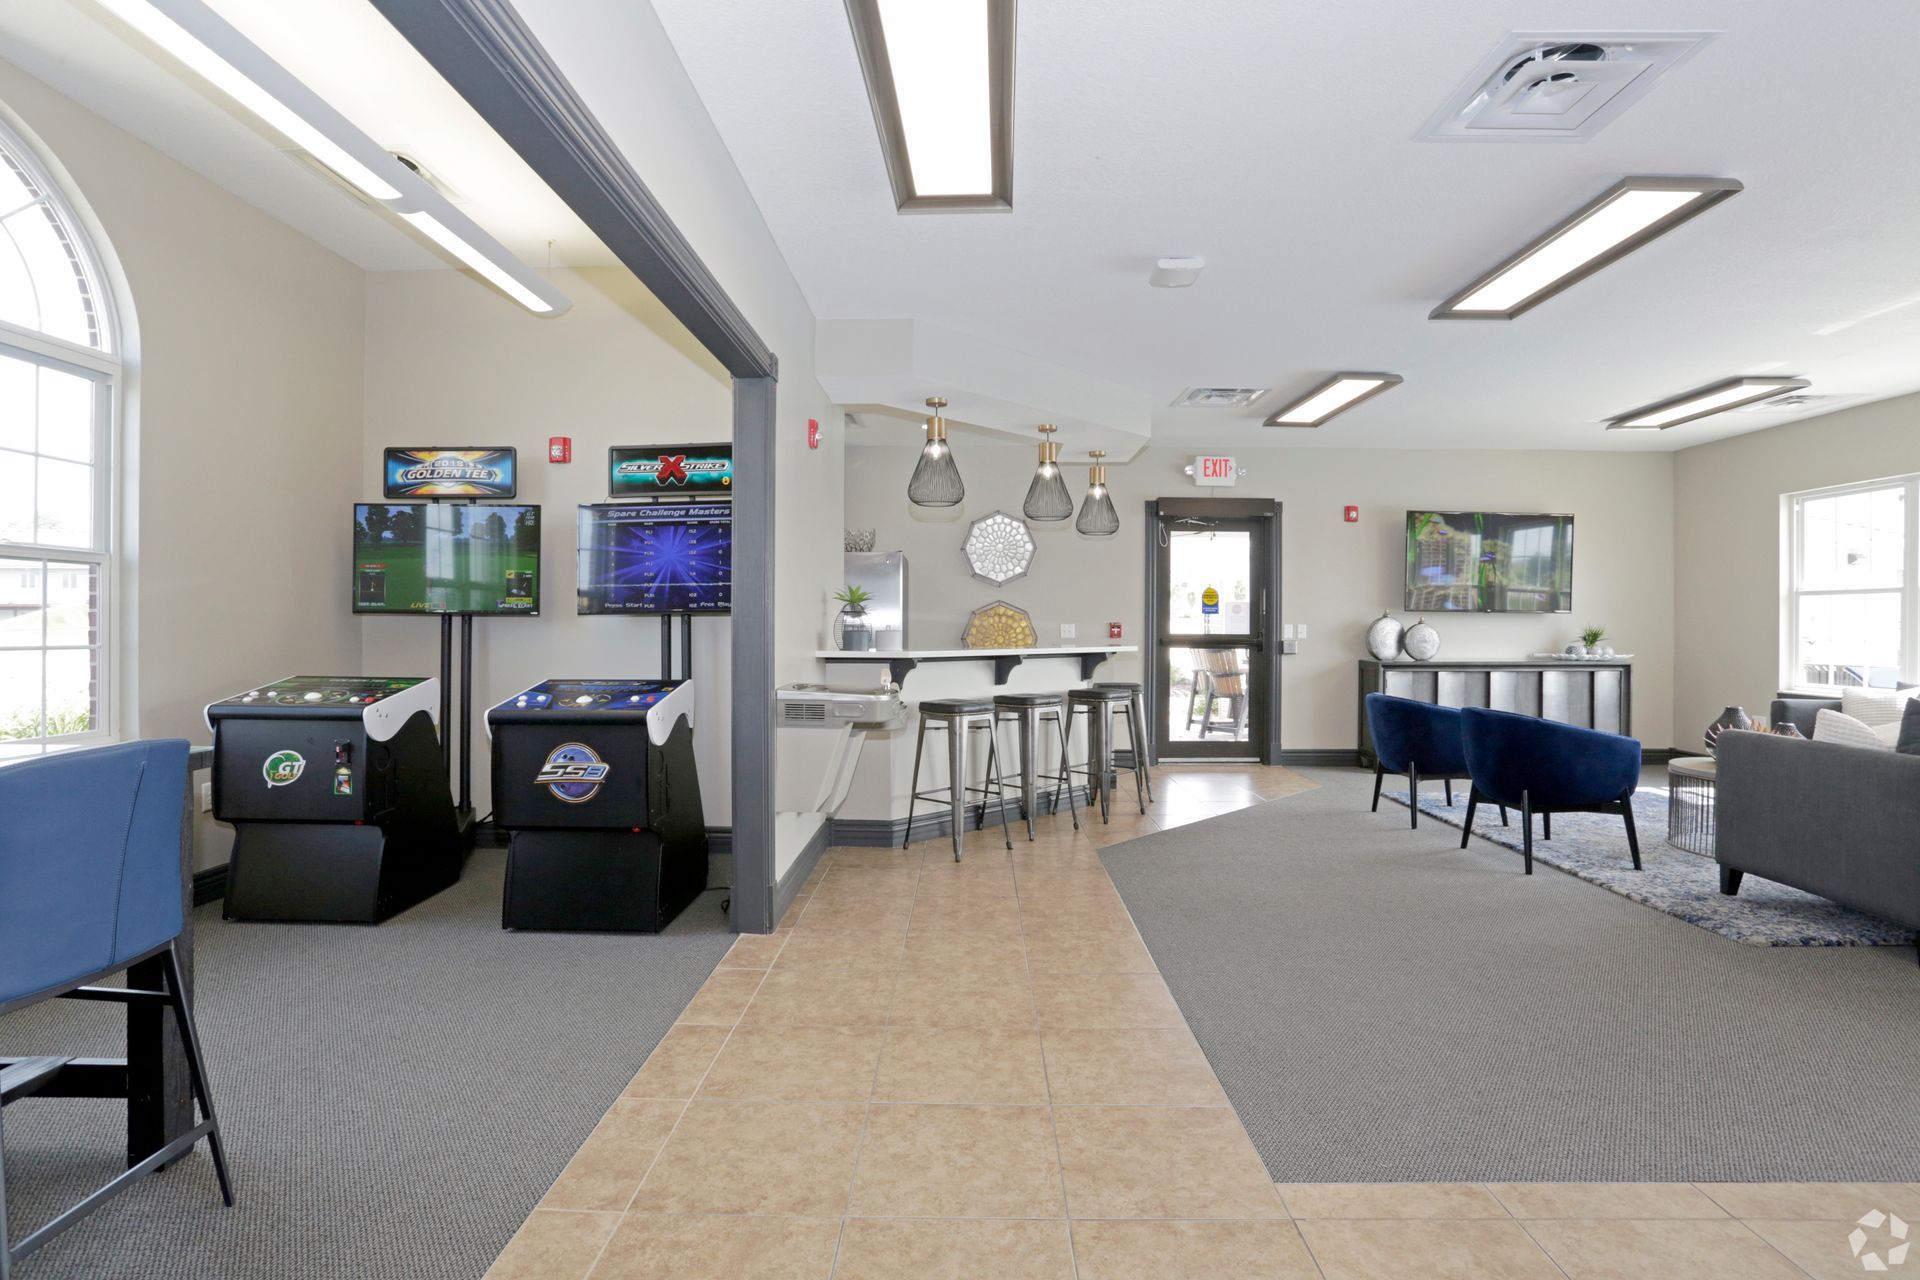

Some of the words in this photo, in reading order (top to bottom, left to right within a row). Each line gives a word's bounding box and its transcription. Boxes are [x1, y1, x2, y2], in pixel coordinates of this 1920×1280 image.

[680, 462, 723, 470] STRIKE
[1203, 458, 1230, 478] EXIT
[407, 469, 461, 479] GOLDEN
[464, 469, 488, 478] TEE
[607, 510, 637, 518] Spare
[639, 508, 686, 517] Challenge
[278, 761, 304, 774] GT
